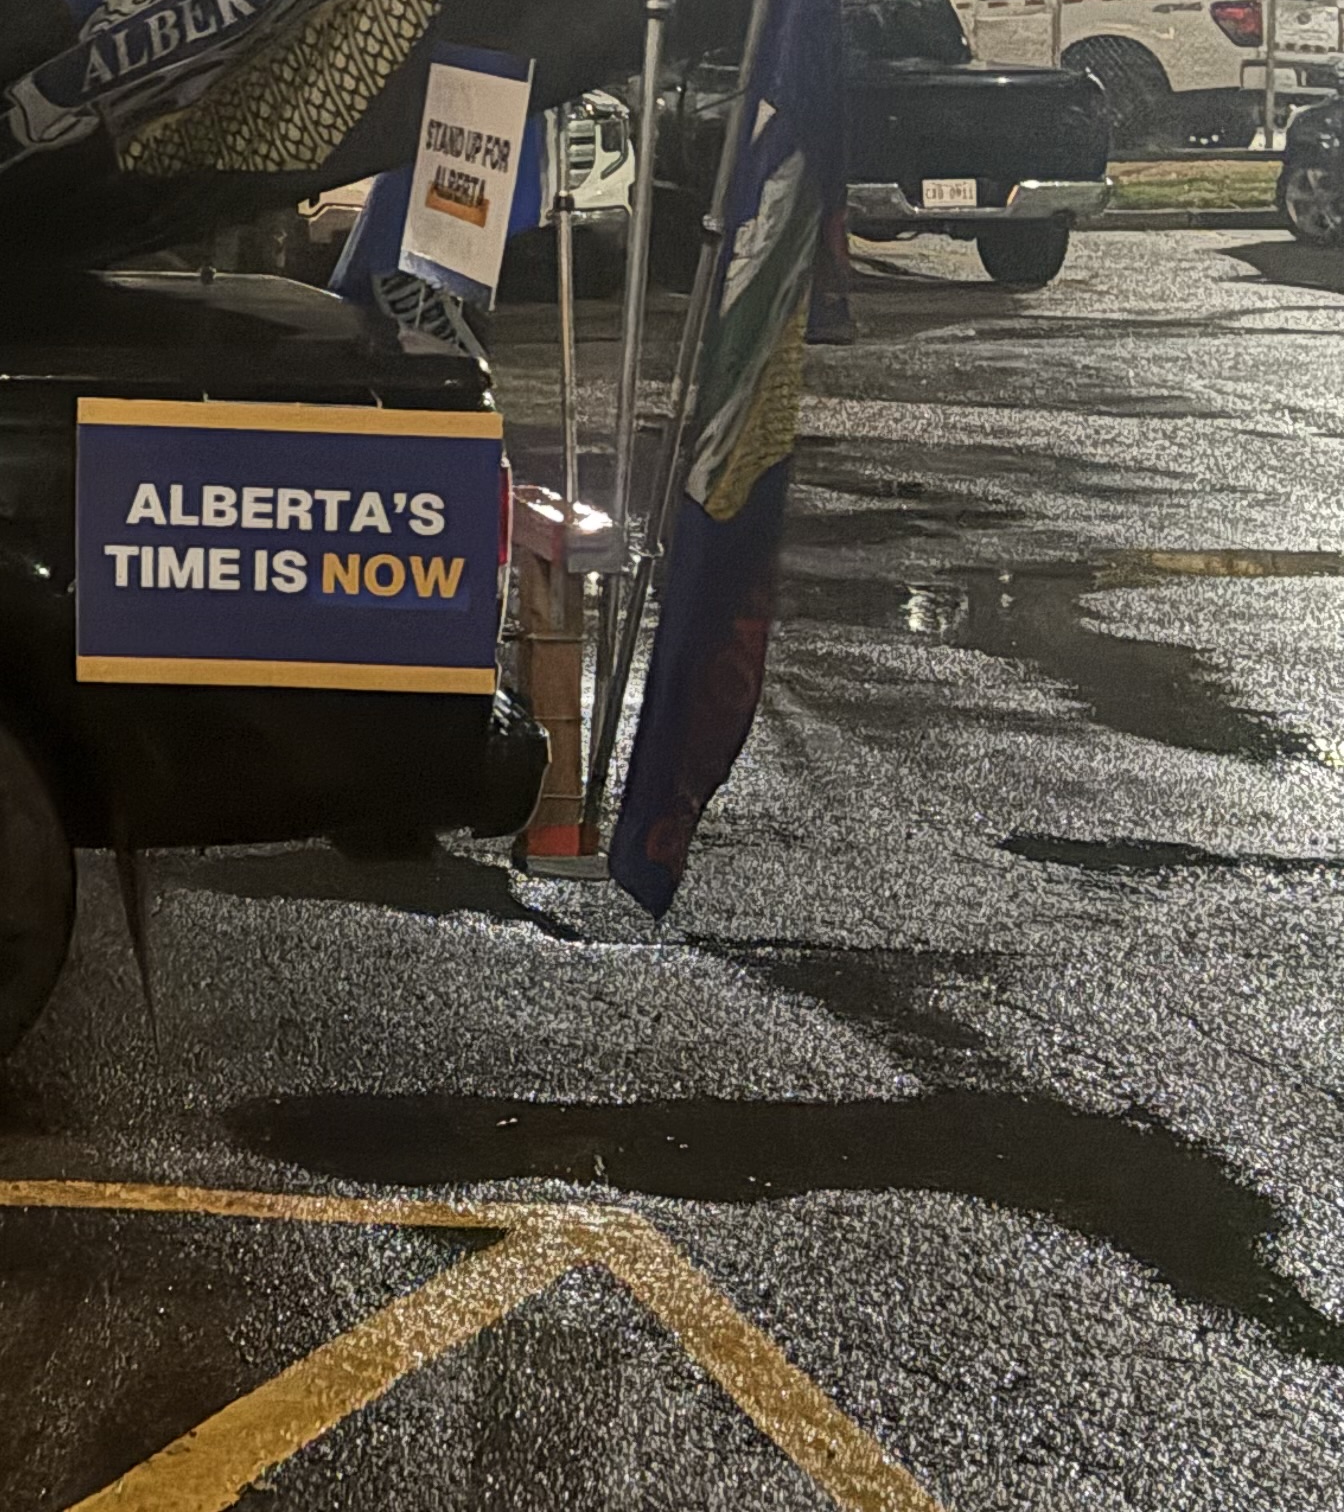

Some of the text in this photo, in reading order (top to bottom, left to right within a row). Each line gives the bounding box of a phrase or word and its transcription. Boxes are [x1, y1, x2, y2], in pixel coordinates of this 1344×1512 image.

[425, 119, 511, 173] STAND UP FOR
[126, 482, 446, 537] ALBERTA'S
[104, 544, 465, 599] TIME IS NOW
